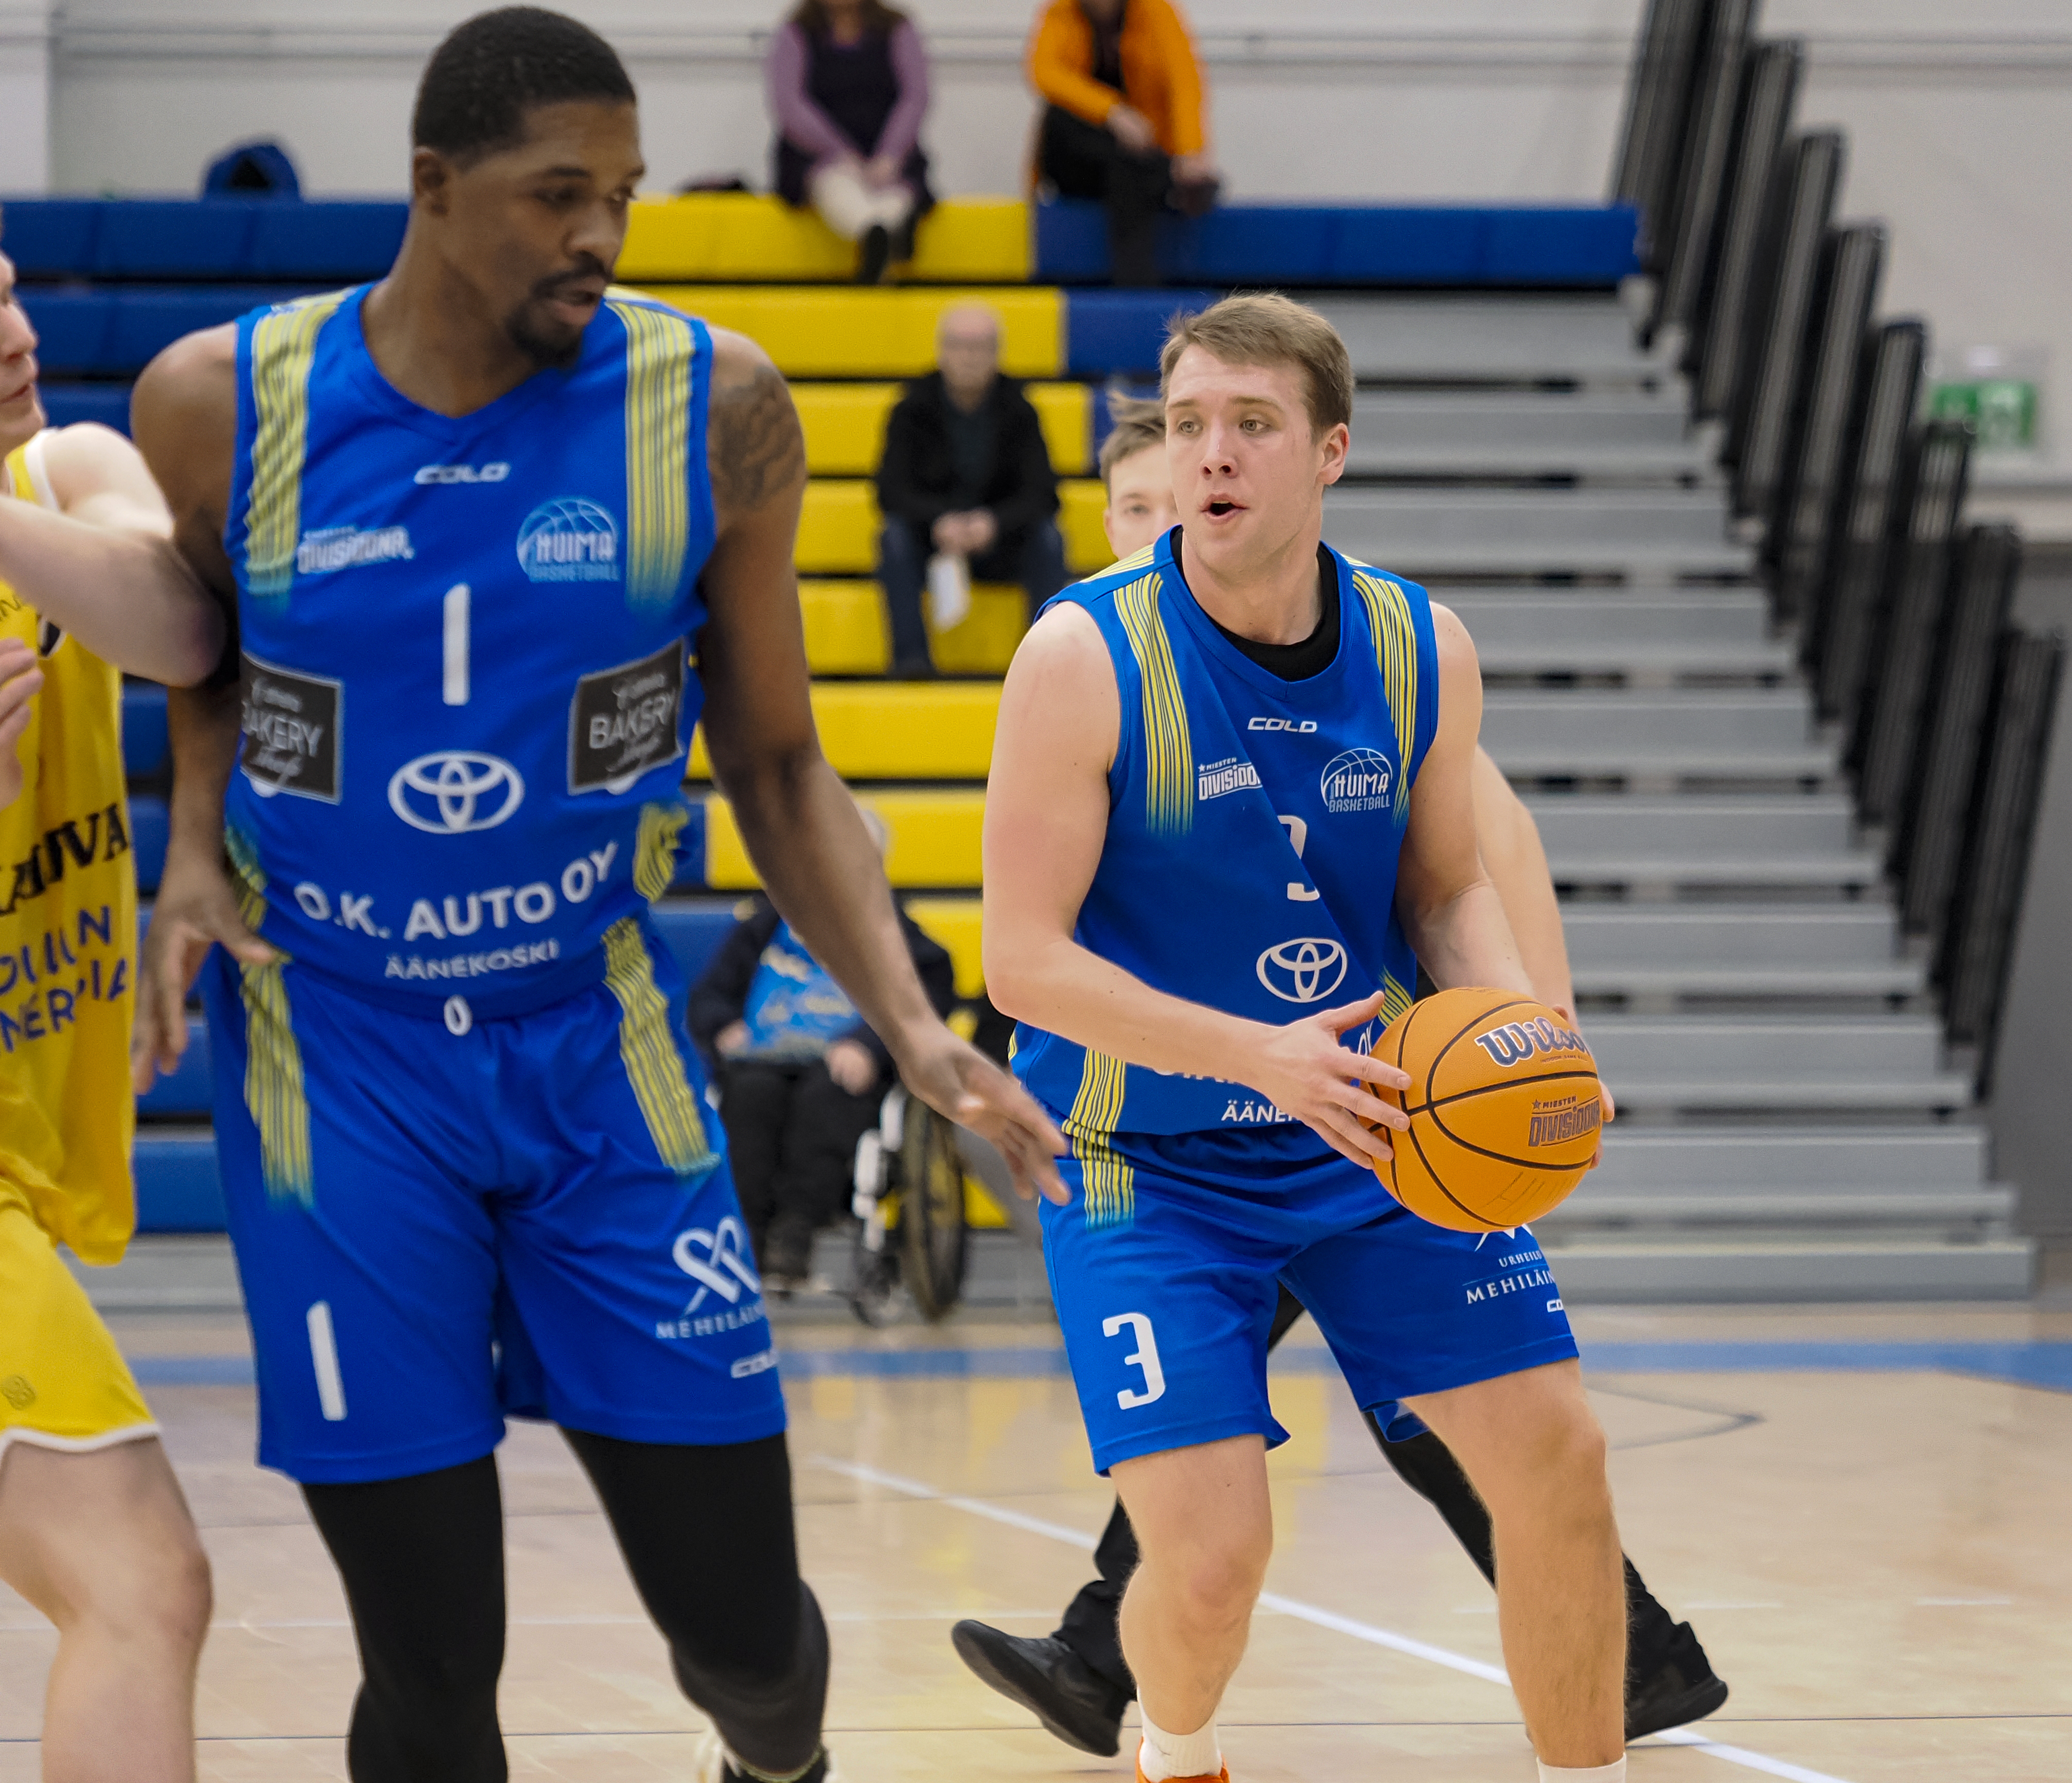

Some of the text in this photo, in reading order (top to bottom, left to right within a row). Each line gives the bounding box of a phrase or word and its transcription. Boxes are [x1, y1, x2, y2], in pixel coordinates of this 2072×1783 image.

[413, 462, 511, 485] COLD
[443, 583, 470, 706] 1
[1248, 717, 1317, 733] COLD
[1206, 757, 1237, 771] MIESTEN
[1334, 773, 1389, 797] HUIMA
[1329, 795, 1390, 813] BASKETBALL
[403, 880, 556, 942] AUTO
[560, 839, 619, 904] OY
[384, 938, 560, 980] ÄÄNEKOSKI
[1542, 1095, 1577, 1109] MIESTEN
[306, 1300, 348, 1421] 1
[1102, 1312, 1166, 1411] 3
